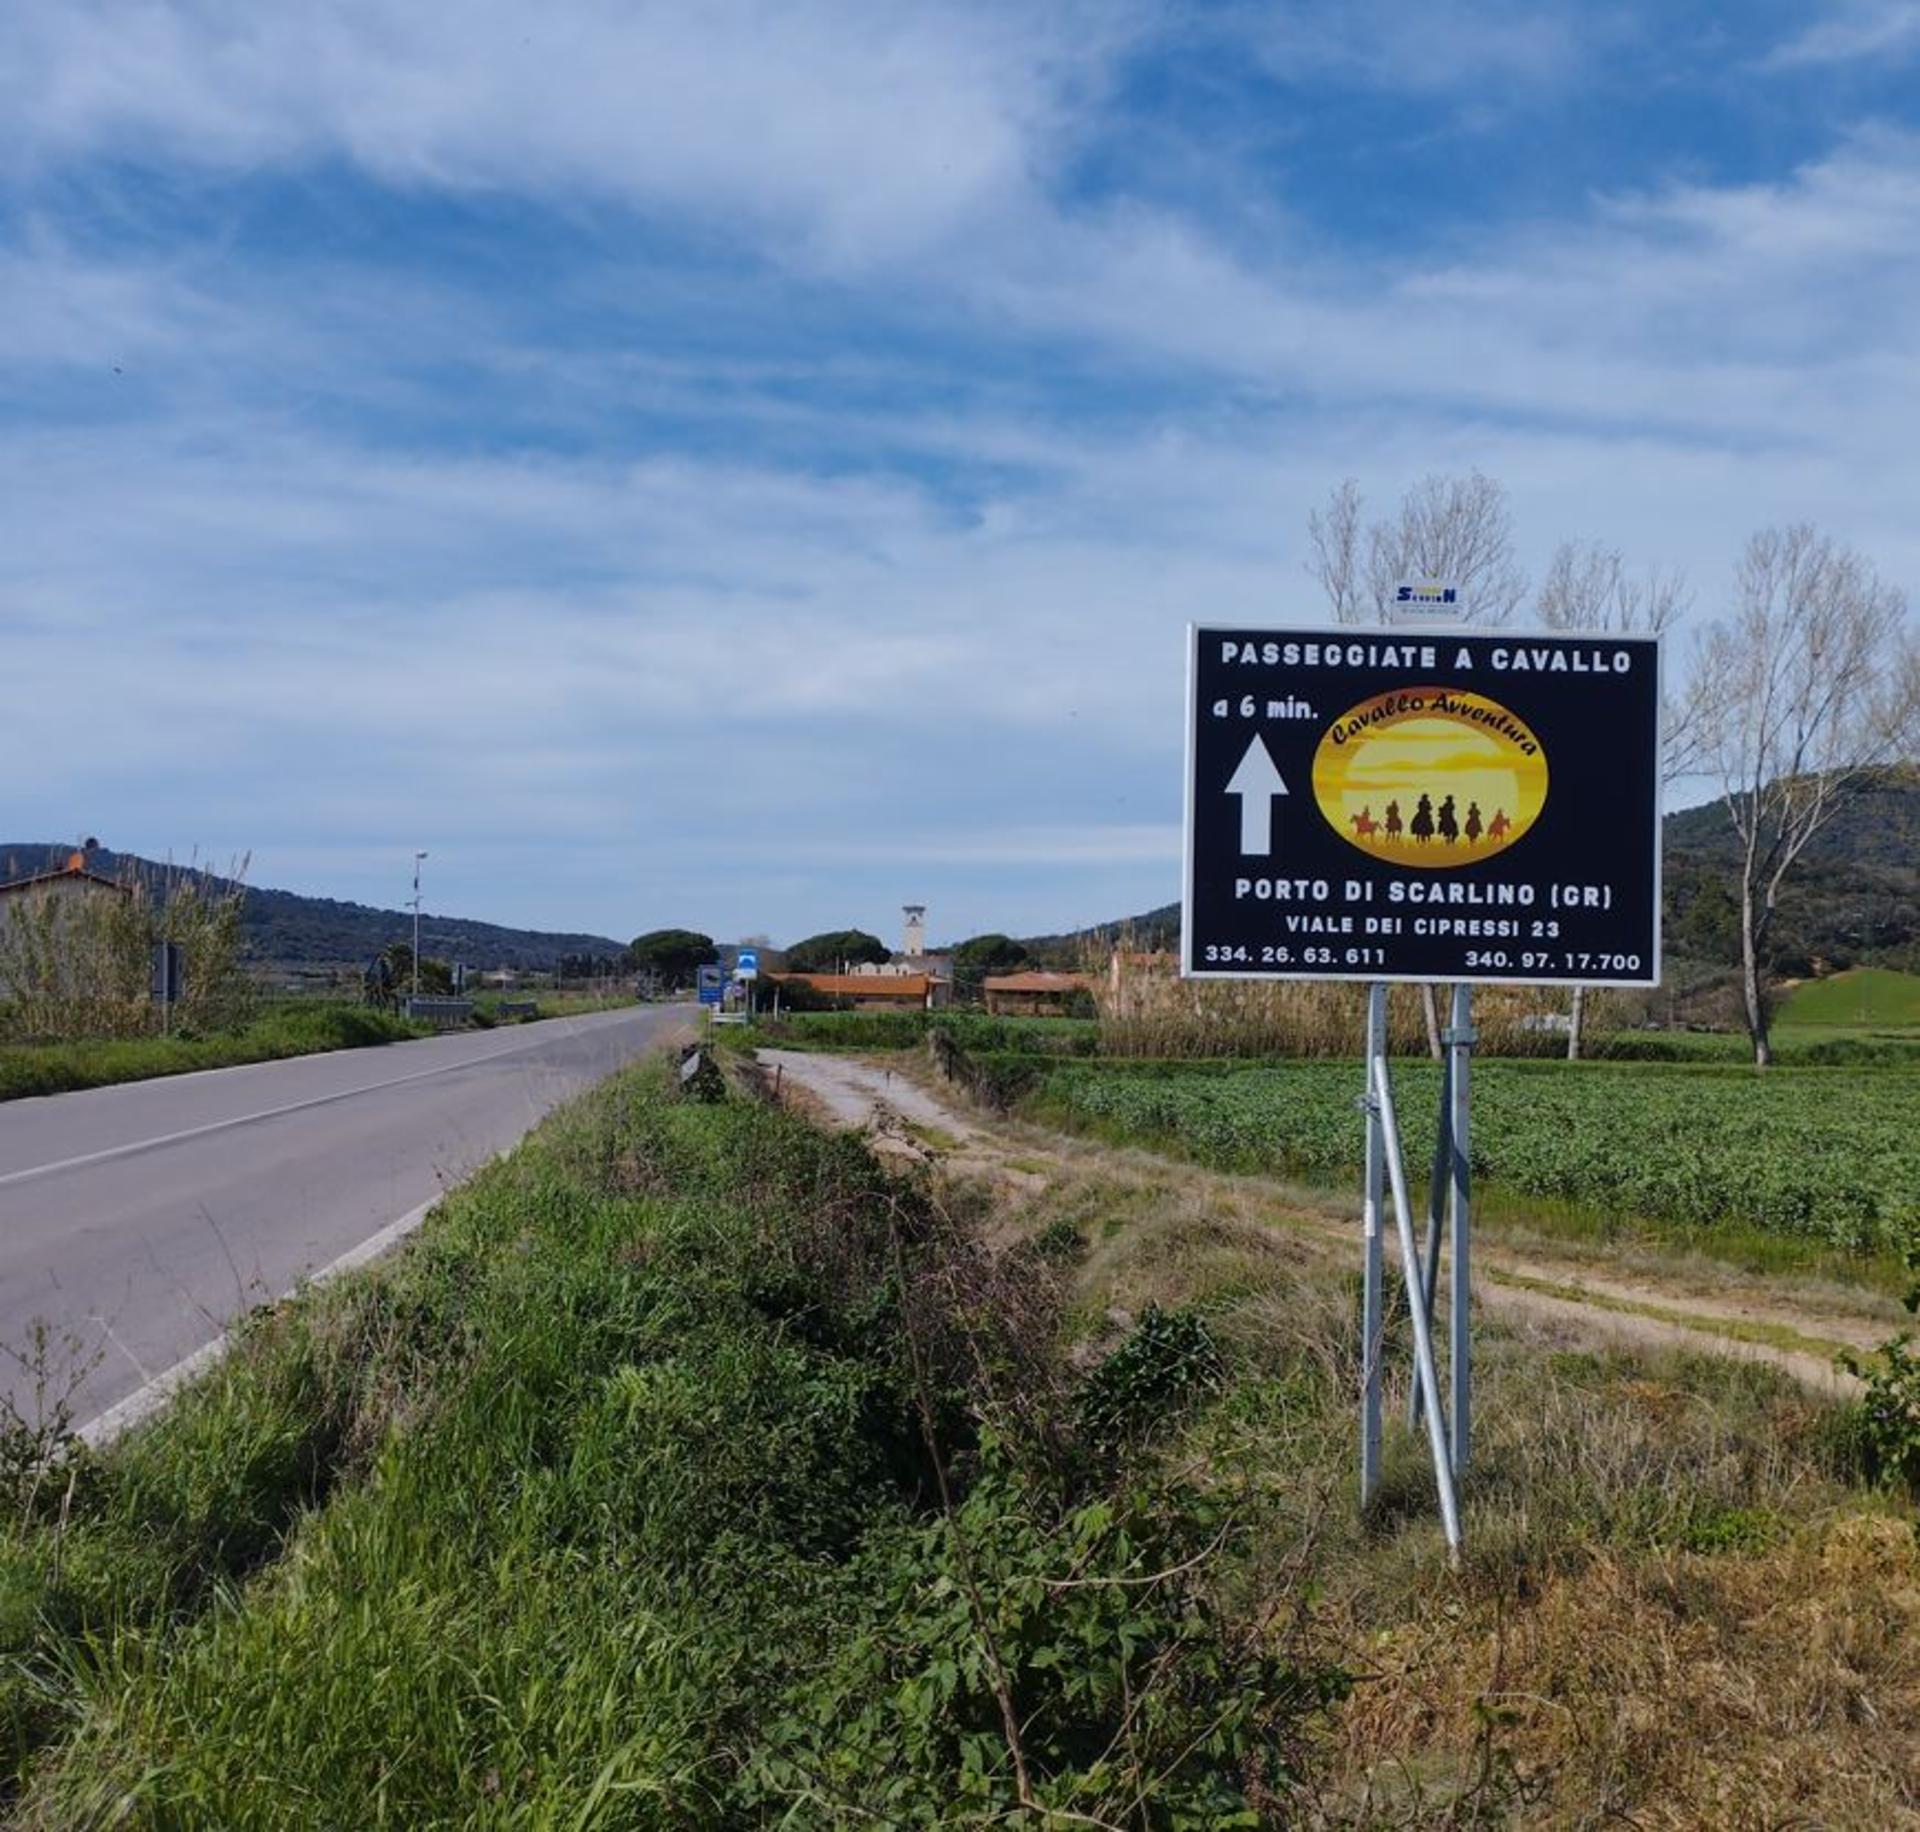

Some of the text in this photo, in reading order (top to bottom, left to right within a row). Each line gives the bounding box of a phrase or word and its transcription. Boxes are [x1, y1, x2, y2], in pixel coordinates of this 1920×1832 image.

[1221, 641, 1631, 674] PASSEGGIATE A CAVALLO
[1212, 694, 1319, 719] a 6 min.
[1332, 692, 1538, 756] Cavallo Avventura
[1235, 878, 1611, 910] PORTO DI SCARLINO (GR)
[1285, 915, 1560, 938] VIALE DEI CIPRESSI 23
[1345, 948, 1384, 965] 611
